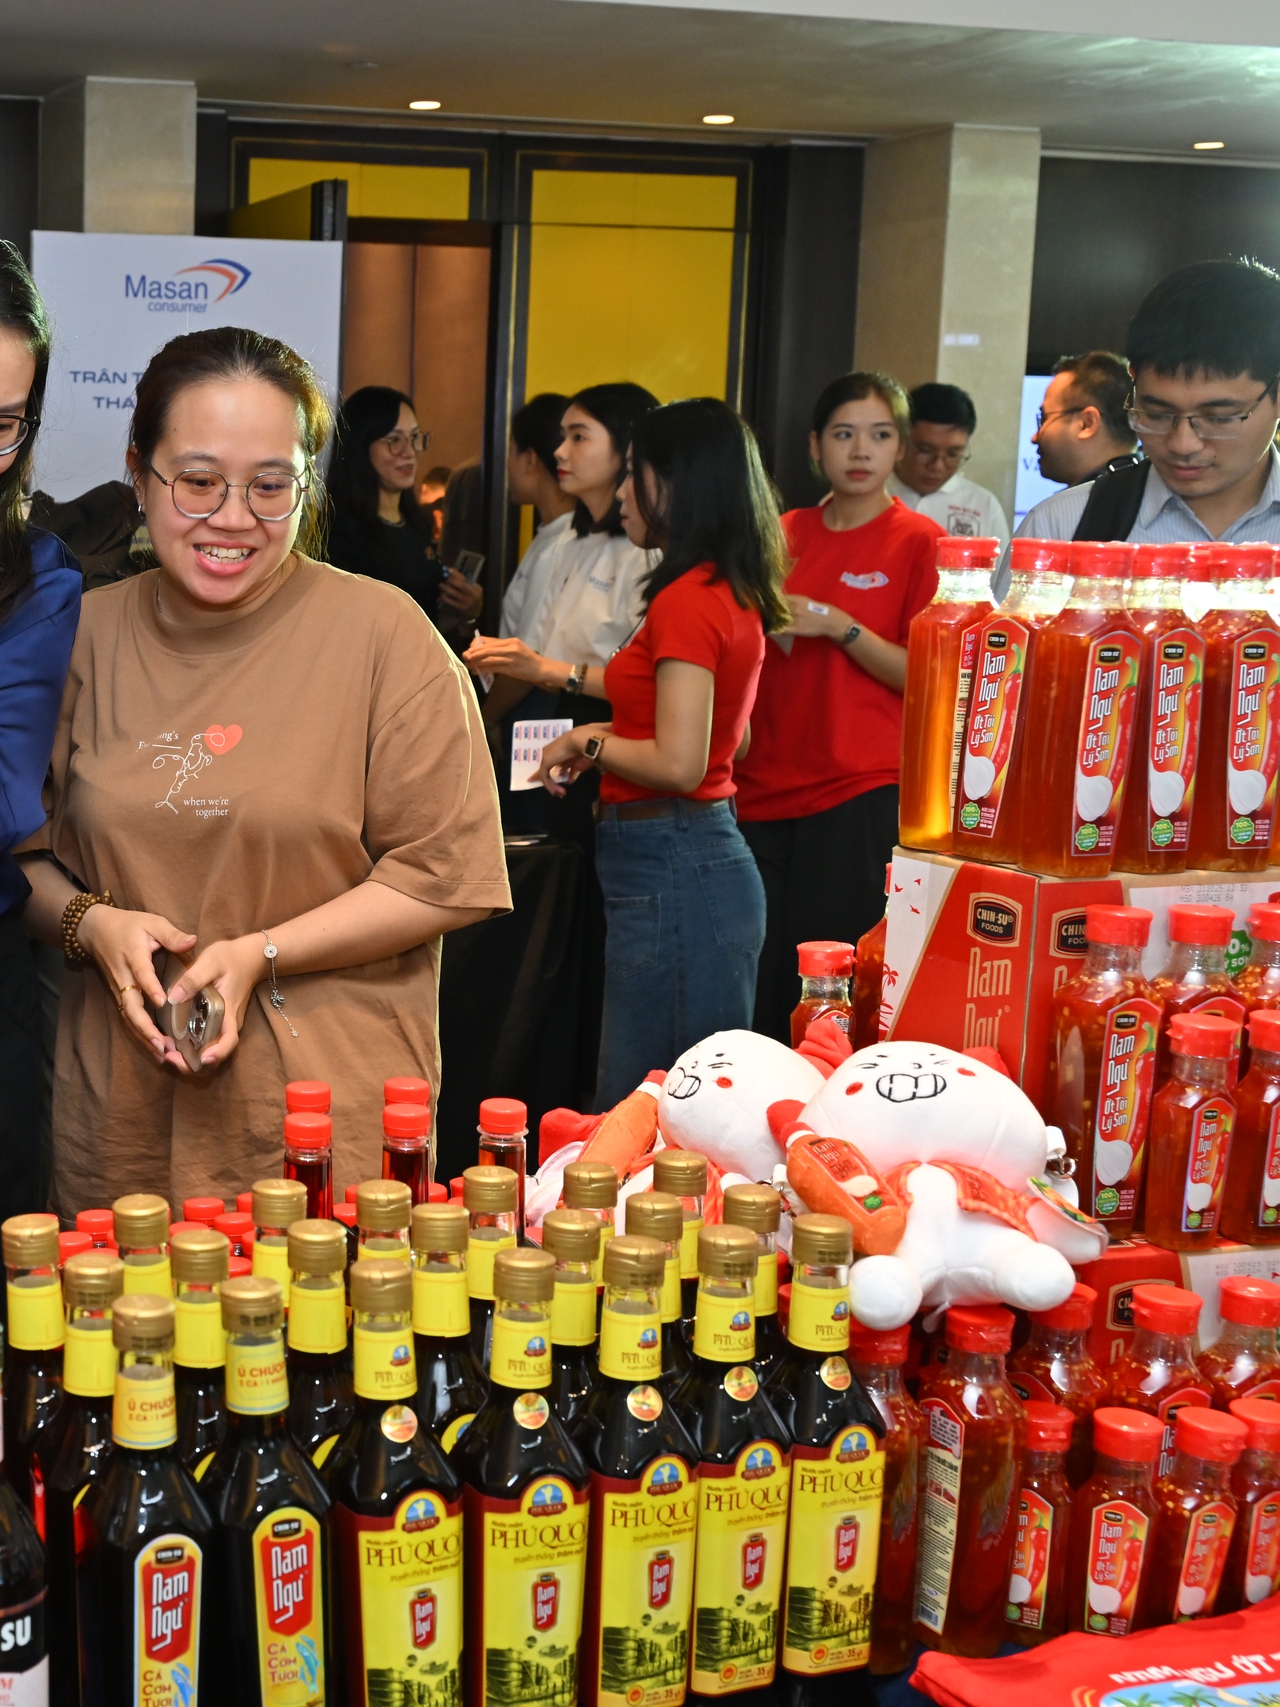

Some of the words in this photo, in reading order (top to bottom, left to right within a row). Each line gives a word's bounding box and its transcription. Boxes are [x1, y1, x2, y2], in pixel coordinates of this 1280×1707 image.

[124, 274, 208, 300] Masan
[148, 301, 208, 313] consumer
[70, 369, 127, 384] TRÂN
[93, 397, 136, 410] THA
[982, 651, 1006, 677] Nam
[1160, 663, 1184, 690] Nam
[1239, 663, 1266, 690] Nam
[1092, 667, 1119, 694] Nam
[977, 677, 1001, 712] Ngư
[1236, 689, 1261, 726] Ngư
[1088, 693, 1114, 731] Ngư
[1157, 690, 1180, 727] Ngư
[183, 797, 206, 806] when
[208, 797, 229, 806] we're
[195, 808, 229, 819] together
[981, 922, 1003, 934] FOODS
[1062, 924, 1087, 936] CHIN
[1068, 937, 1087, 945] FOO
[967, 946, 1012, 998] Nam
[1109, 1033, 1135, 1059] Nam
[1106, 1058, 1130, 1096] Ngư
[799, 1471, 843, 1494] PHÚ
[844, 1467, 885, 1494] QUỐ
[705, 1488, 750, 1512] PHÚ
[750, 1483, 788, 1511] QUỐ
[610, 1504, 656, 1528] PHÚ
[656, 1499, 696, 1527] QUỐ
[490, 1525, 538, 1549] PHÚ
[539, 1519, 587, 1549] QUỐ
[1100, 1522, 1122, 1538] Nam
[271, 1543, 308, 1580] Nam
[366, 1541, 412, 1567] PHÚ
[414, 1533, 461, 1565] QUỐ
[152, 1570, 189, 1607] Nam
[273, 1573, 305, 1625] Ngư
[151, 1601, 184, 1652] Ngư
[267, 1642, 287, 1656] CÁ
[143, 1668, 163, 1682] CÁ
[268, 1657, 297, 1670] CƠM
[143, 1683, 172, 1696] CƠM
